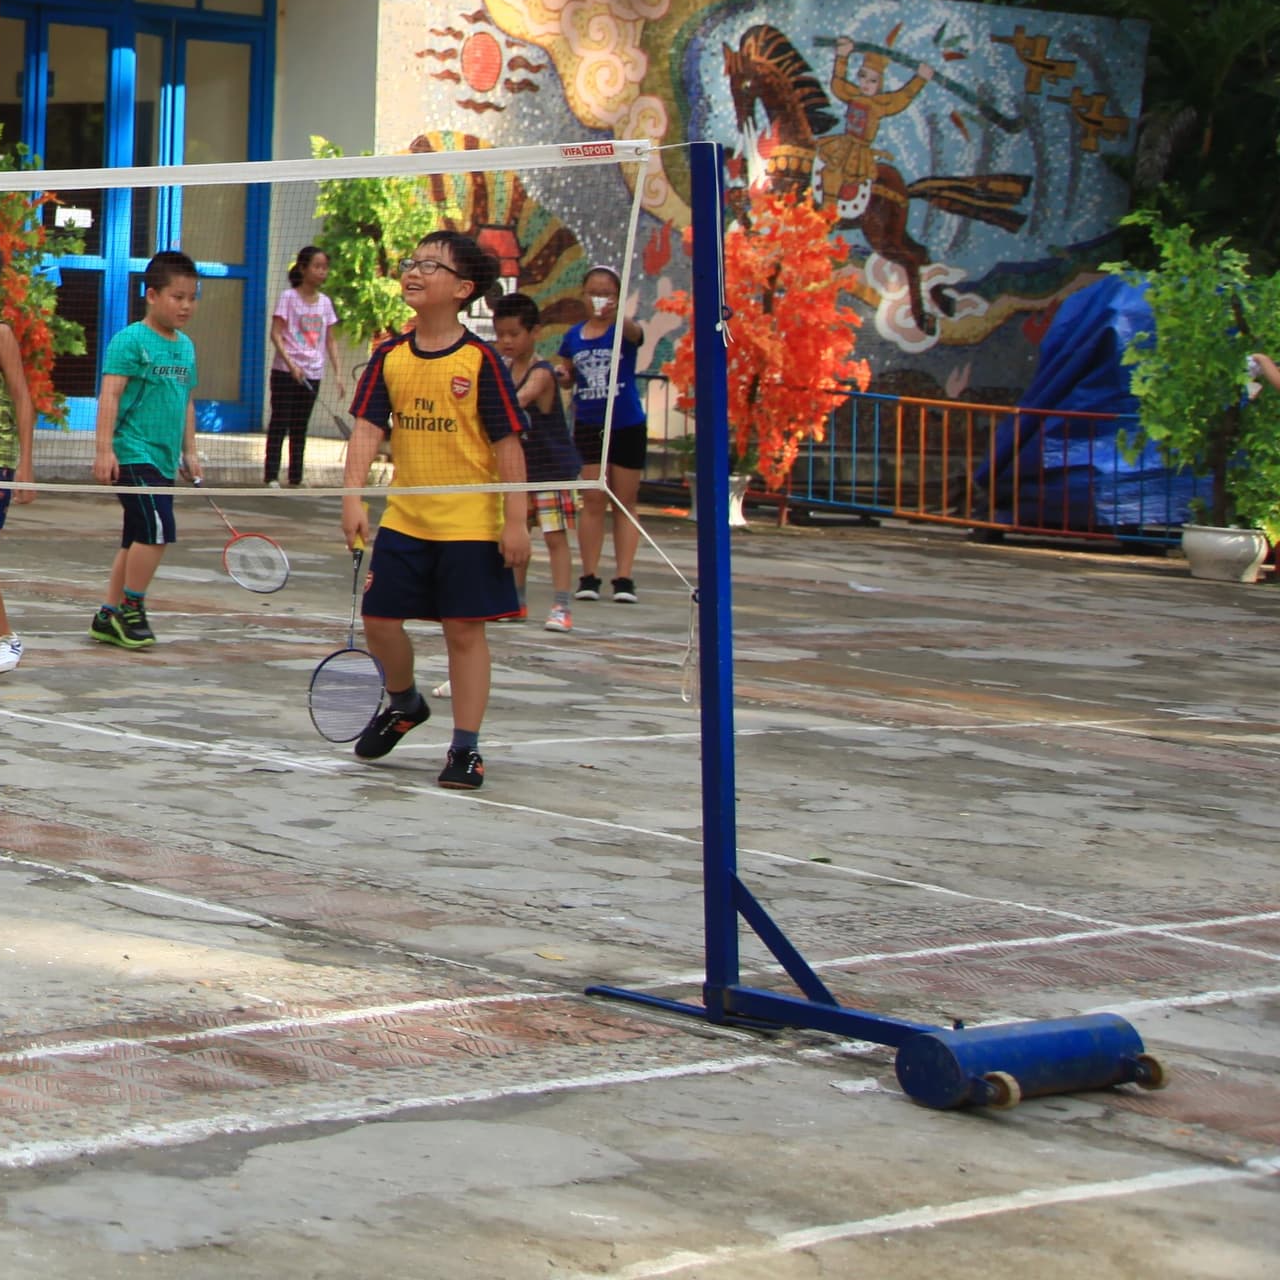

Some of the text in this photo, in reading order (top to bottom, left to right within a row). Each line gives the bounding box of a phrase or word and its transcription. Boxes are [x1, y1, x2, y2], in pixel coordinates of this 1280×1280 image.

[562, 144, 612, 156] VIFA SPORT
[414, 397, 434, 413] Fly
